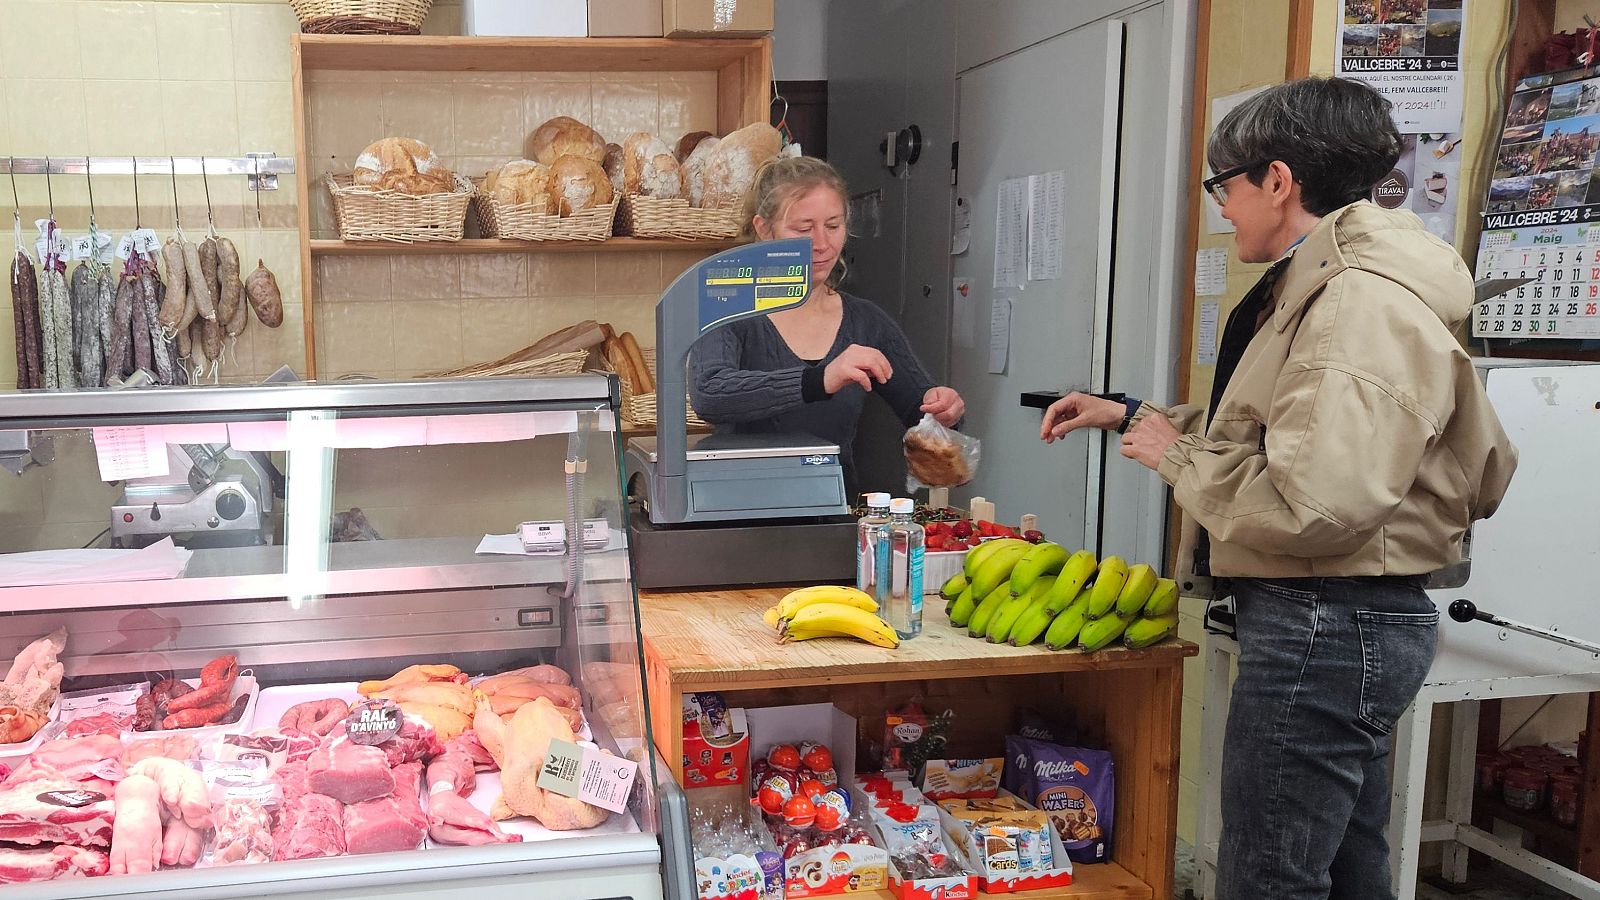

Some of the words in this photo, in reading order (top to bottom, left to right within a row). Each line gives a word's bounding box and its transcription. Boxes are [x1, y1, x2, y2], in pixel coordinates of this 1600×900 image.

[1344, 59, 1406, 71] VALLCEBRE
[1407, 58, 1422, 70] '24
[1377, 187, 1405, 195] TIRAVAL
[1486, 210, 1559, 229] VALLCEBRE
[1559, 208, 1579, 222] '24
[1533, 234, 1563, 245] Maig
[1522, 254, 1528, 265] 1
[1539, 252, 1546, 265] 2
[1557, 252, 1564, 264] 3
[1575, 250, 1583, 263] 4
[1553, 269, 1563, 281] 10
[1572, 268, 1581, 281] 11
[1591, 267, 1600, 280] 12
[1516, 286, 1525, 299] 15
[1533, 286, 1543, 299] 16
[1552, 286, 1561, 298] 17
[1570, 285, 1580, 298] 18
[1589, 285, 1598, 297] 19
[1480, 304, 1490, 316] 20
[1496, 303, 1506, 316] 21
[1513, 303, 1524, 316] 22
[1530, 303, 1542, 316] 23
[1548, 303, 1560, 316] 24
[1566, 302, 1578, 315] 25
[1585, 302, 1597, 315] 26
[1479, 320, 1489, 332] 27
[1493, 320, 1505, 332] 28
[1511, 320, 1522, 332] 29
[1528, 320, 1540, 332] 30
[1547, 320, 1557, 332] 31
[361, 709, 388, 722] RAL
[351, 718, 396, 732] D'AVINYÓ
[1034, 760, 1077, 777] Milka
[1049, 792, 1067, 800] MINI
[1042, 799, 1085, 811] WAFERS
[989, 860, 1018, 870] Cards
